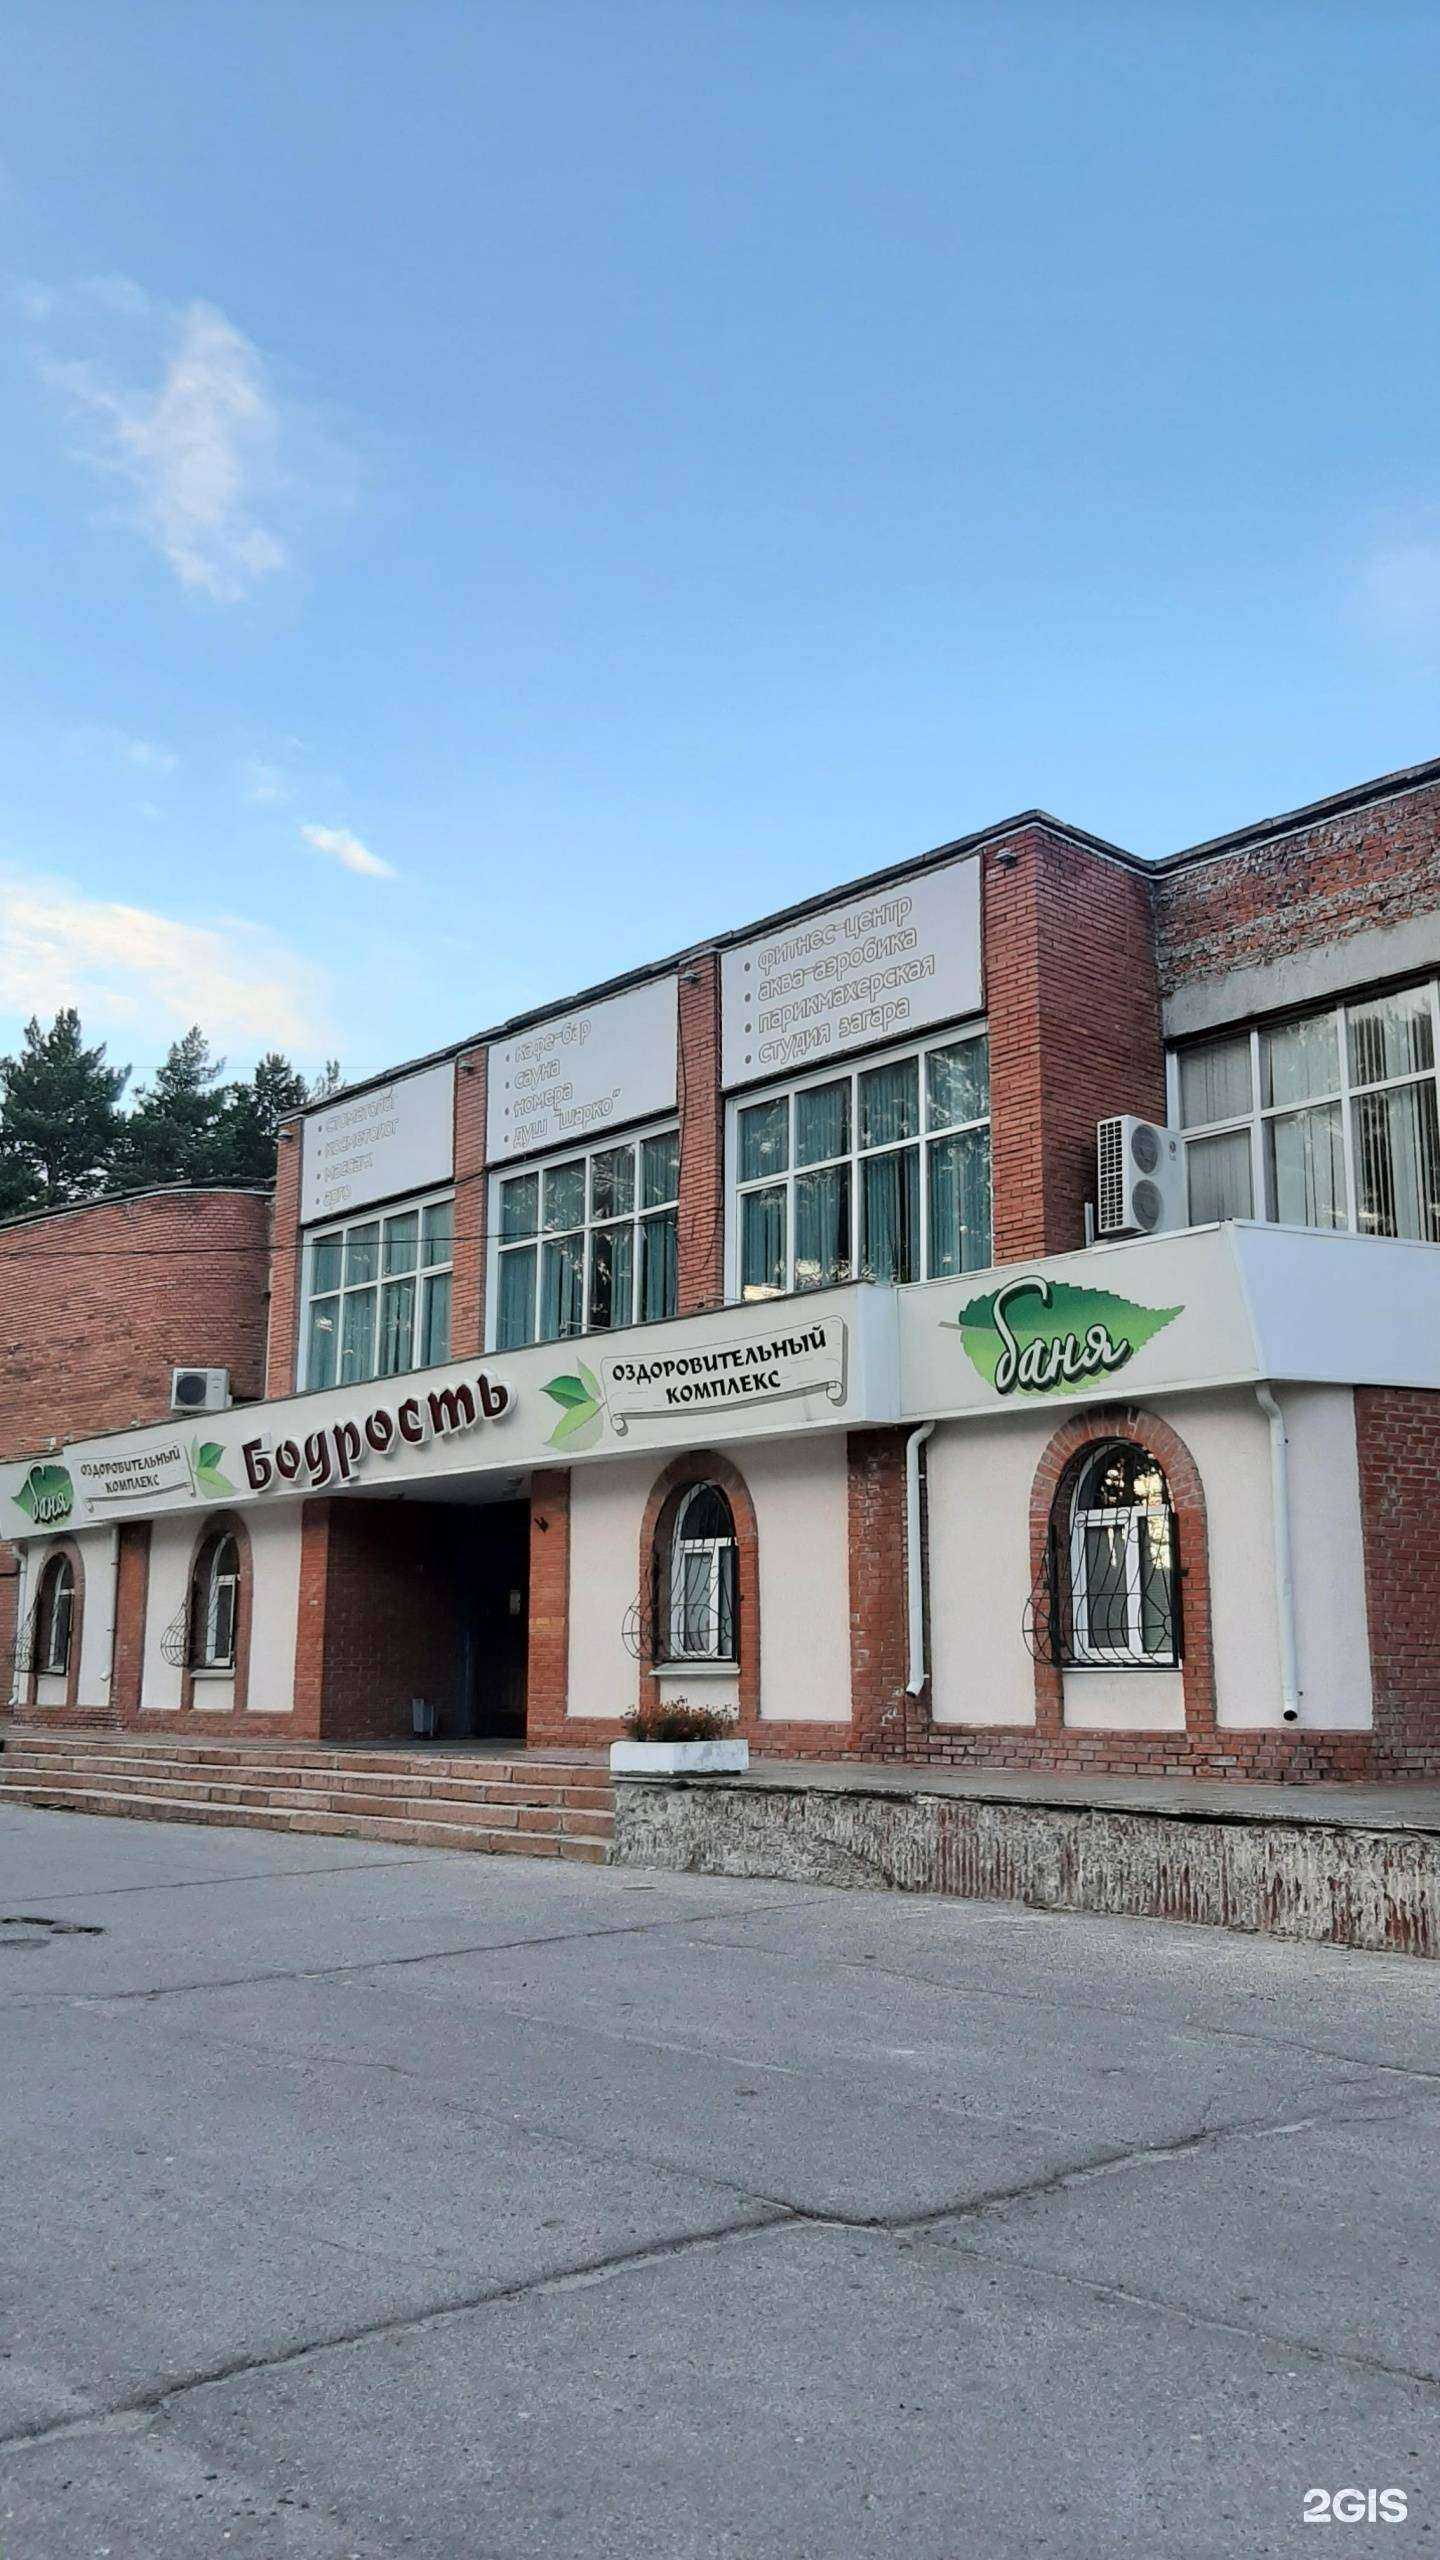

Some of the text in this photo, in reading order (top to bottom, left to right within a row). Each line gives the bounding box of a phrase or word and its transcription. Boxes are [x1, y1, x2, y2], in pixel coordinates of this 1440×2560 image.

[758, 897, 912, 976] фитнес-центр
[758, 928, 917, 1001] аква-аэробика
[758, 955, 935, 1034] парикмахерская
[758, 997, 910, 1064] студия загара
[514, 1058, 560, 1091] сауна
[513, 1082, 573, 1118] номера
[512, 1117, 548, 1149] душ
[612, 1325, 828, 1385] ОЗДОРОВИТЕЛЬНЫЙ
[665, 1370, 782, 1405] КОМПЛЕКС
[241, 1369, 515, 1493] Бодрость
[80, 1446, 181, 1479] ОЗДОРОВИТЕЛЬНЫЙ
[105, 1475, 160, 1494] КОМПЛЕКС
